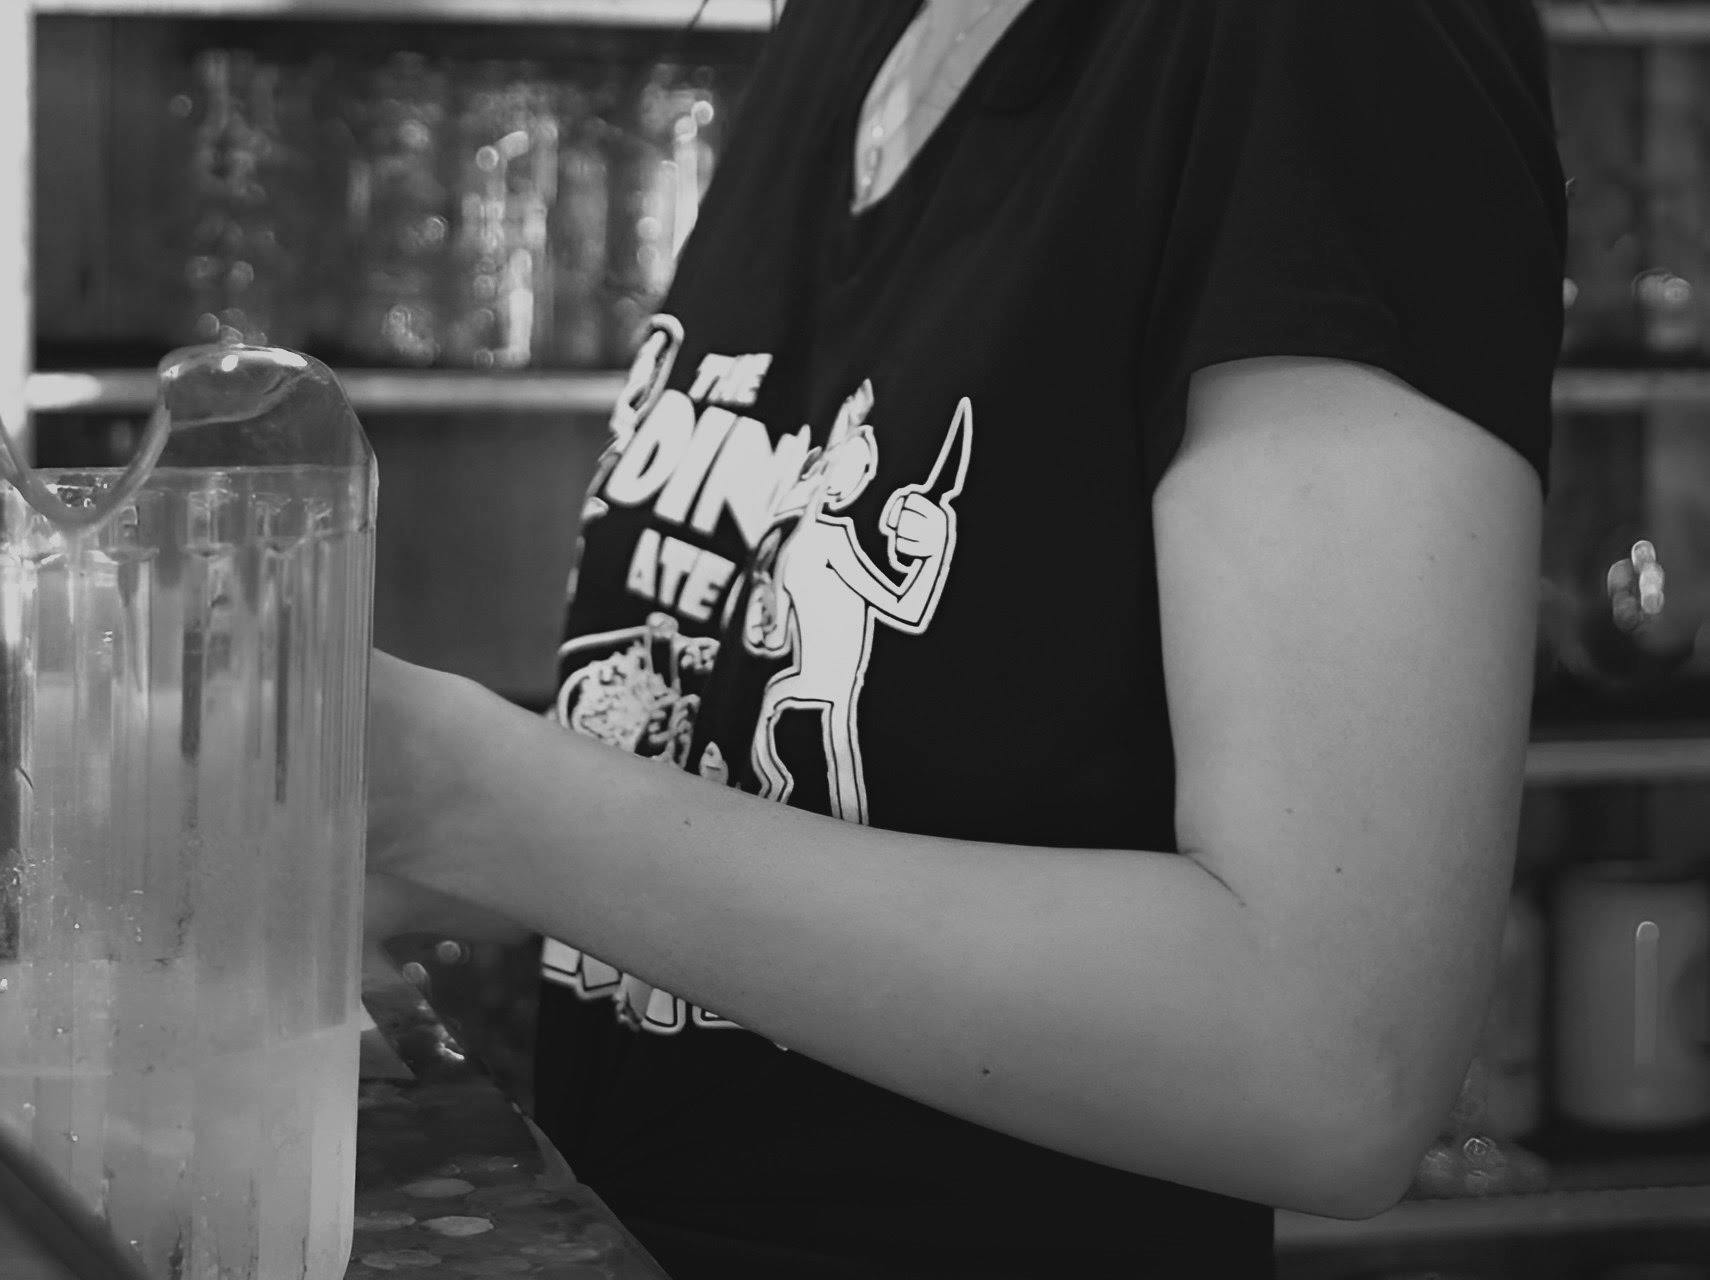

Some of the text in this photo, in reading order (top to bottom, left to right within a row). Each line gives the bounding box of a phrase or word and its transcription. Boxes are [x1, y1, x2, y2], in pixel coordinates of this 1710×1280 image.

[688, 353, 773, 405] THE
[604, 388, 806, 550] DIN
[626, 528, 736, 622] ATE
